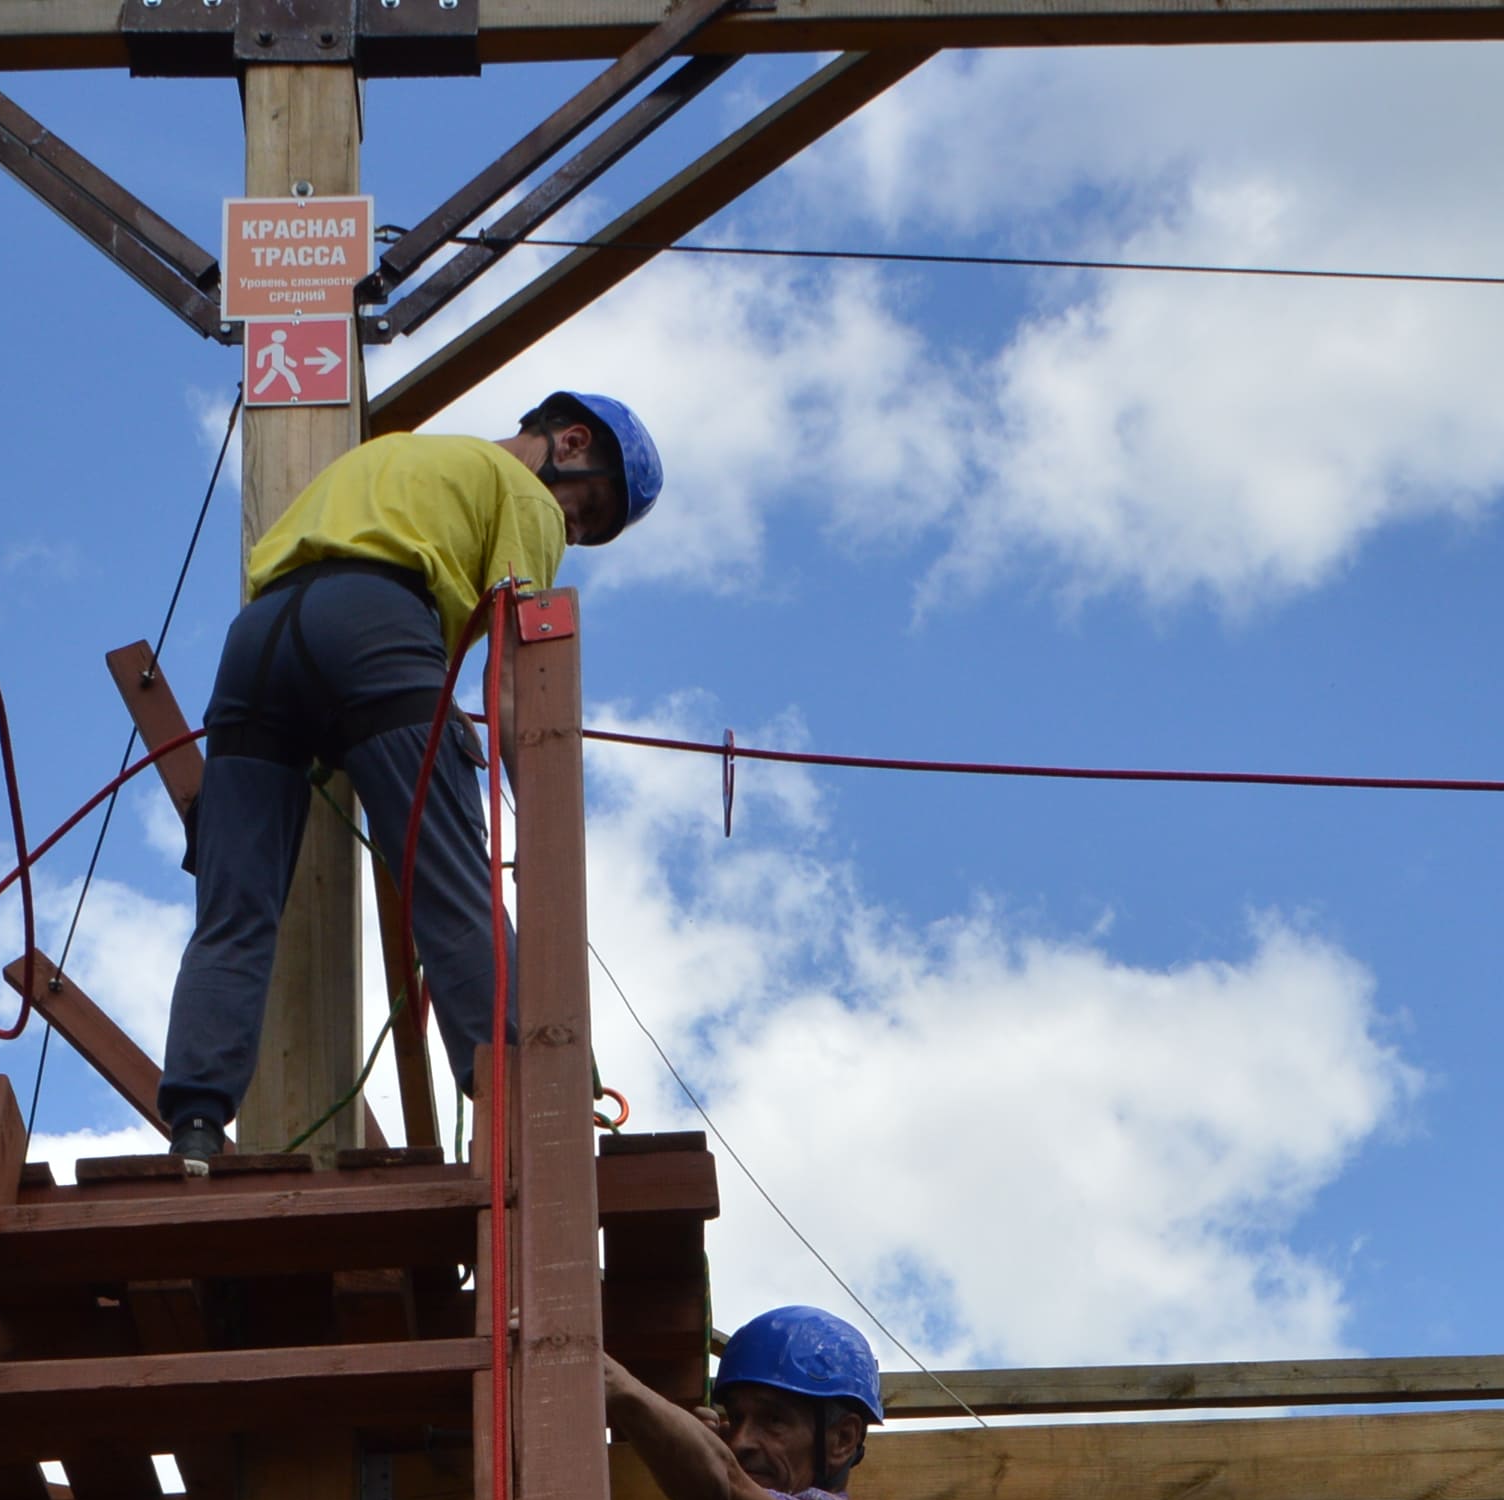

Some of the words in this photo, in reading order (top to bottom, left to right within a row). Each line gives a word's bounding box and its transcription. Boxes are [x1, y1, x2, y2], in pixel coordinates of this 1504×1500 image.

[242, 218, 356, 239] КРАСНАЯ
[251, 246, 346, 266] ТРАССА
[239, 277, 288, 289] Уровень
[269, 290, 325, 302] СРЕДНИЙ
